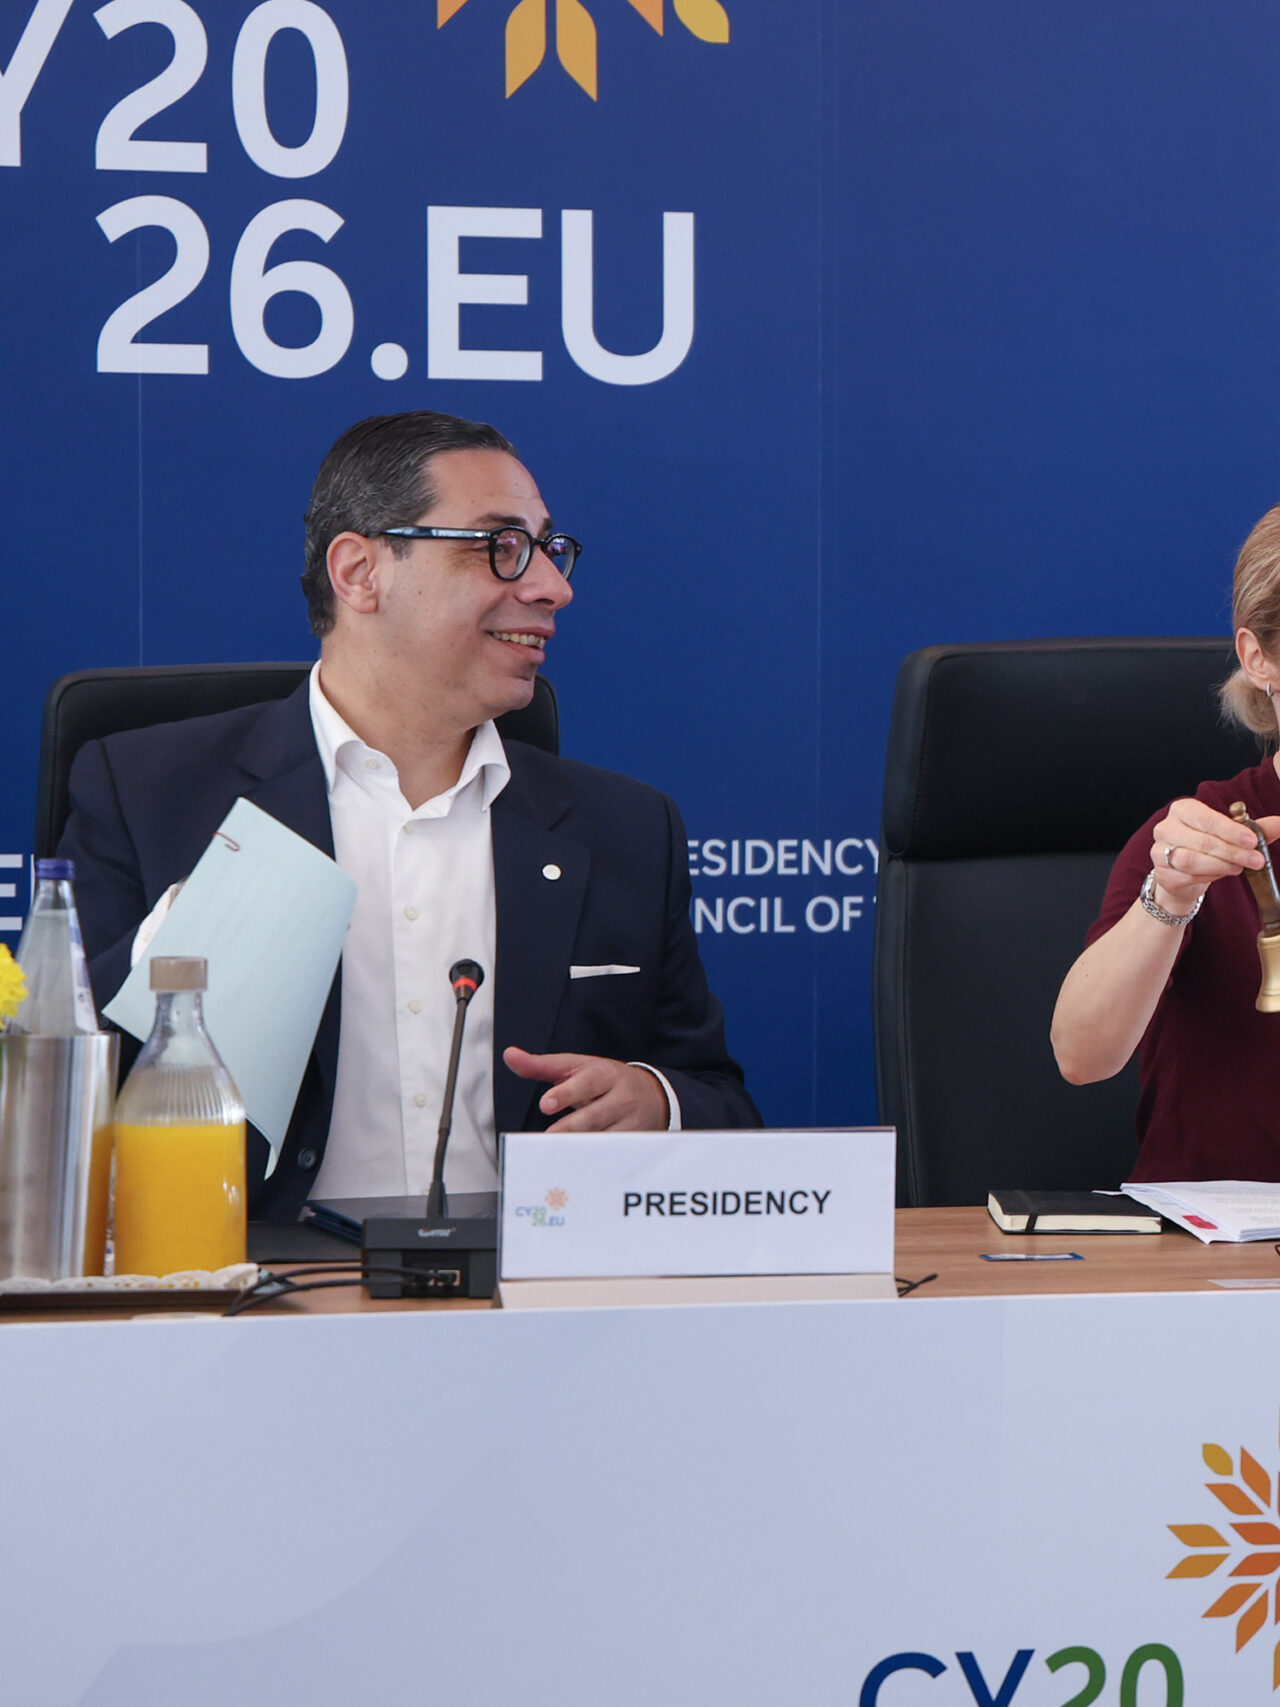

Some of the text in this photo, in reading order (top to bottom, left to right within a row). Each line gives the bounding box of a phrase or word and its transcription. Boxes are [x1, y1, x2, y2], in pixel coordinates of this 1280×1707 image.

[96, 195, 694, 386] 26.EU
[690, 896, 864, 934] NCIL OF
[623, 1190, 832, 1216] PRESIDENCY
[859, 1643, 1184, 1707] CY20
